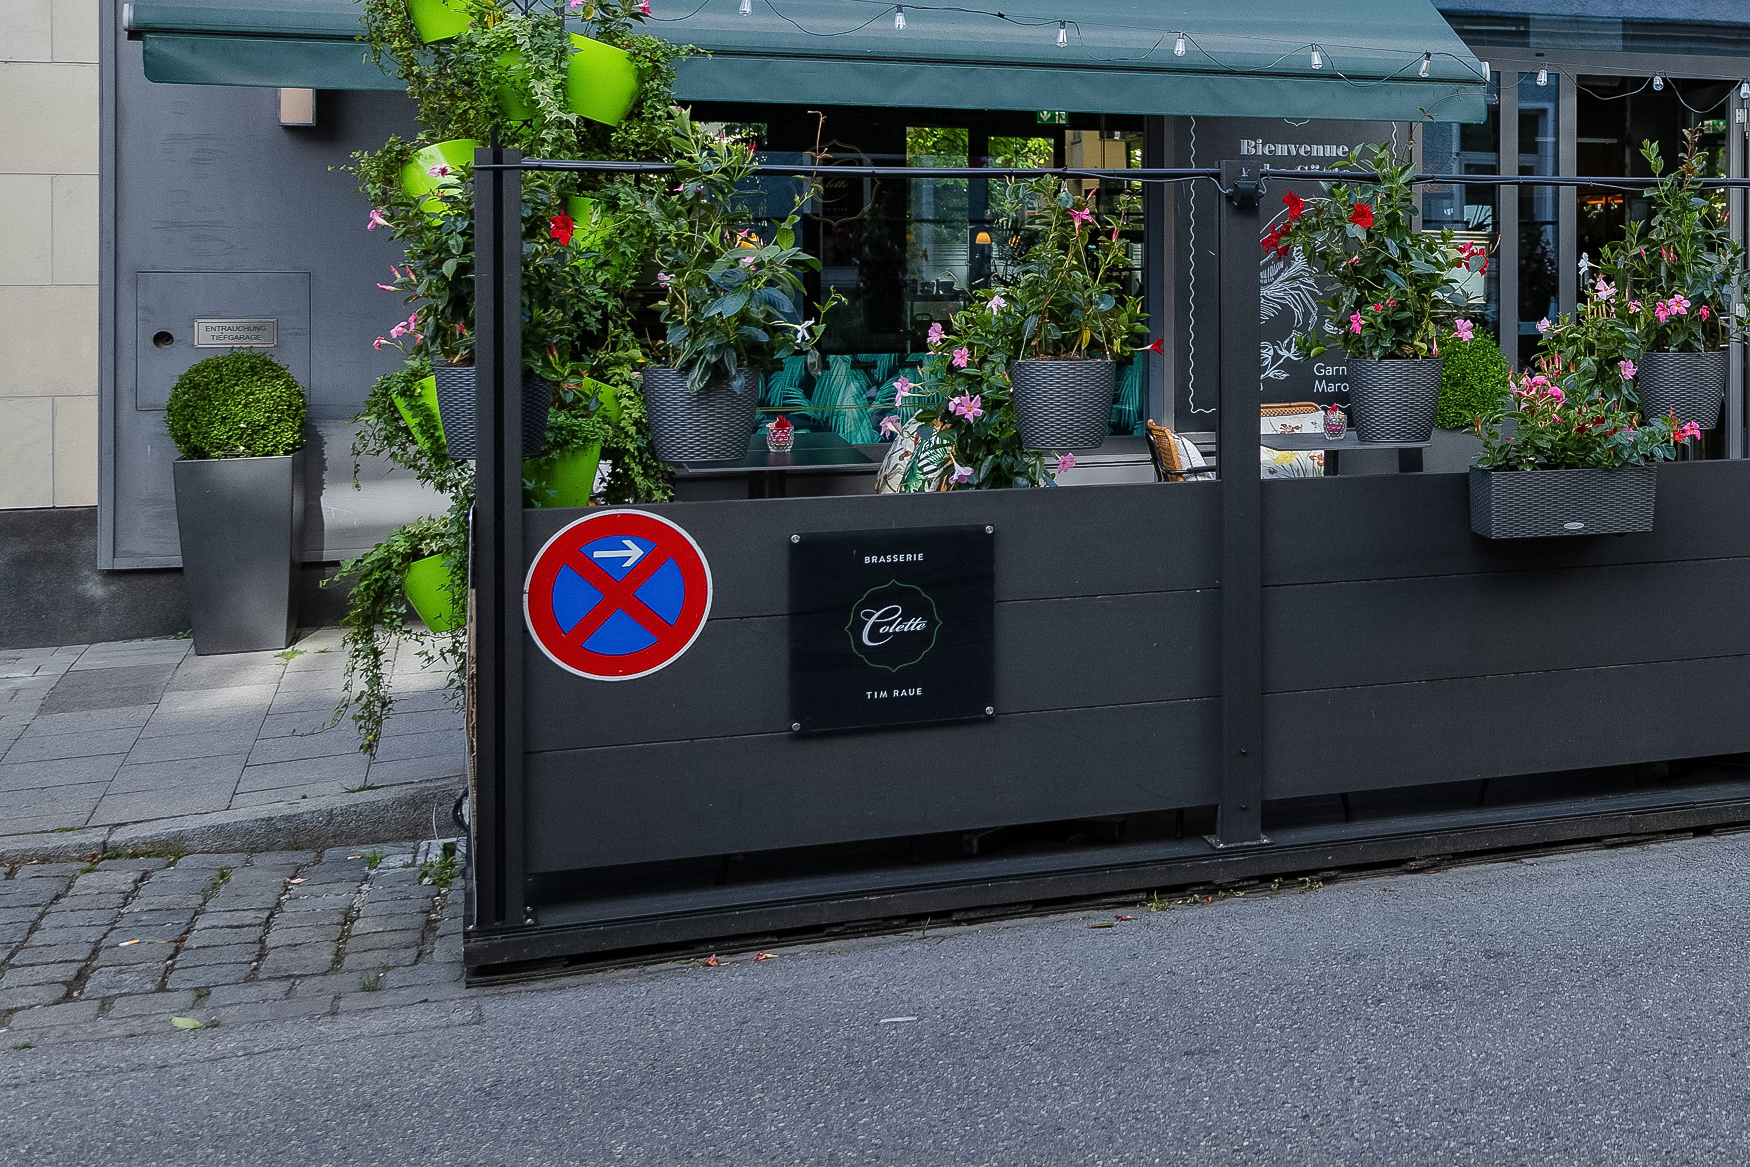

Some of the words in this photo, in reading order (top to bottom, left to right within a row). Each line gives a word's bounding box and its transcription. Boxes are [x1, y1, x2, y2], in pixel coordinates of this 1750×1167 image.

[1239, 138, 1349, 157] Bienvenue
[1313, 362, 1347, 376] Garn
[1313, 379, 1350, 393] Maro
[864, 552, 924, 564] BRASSERIE
[860, 604, 928, 647] Colette
[866, 690, 888, 700] TIM
[892, 687, 923, 698] RAUE
